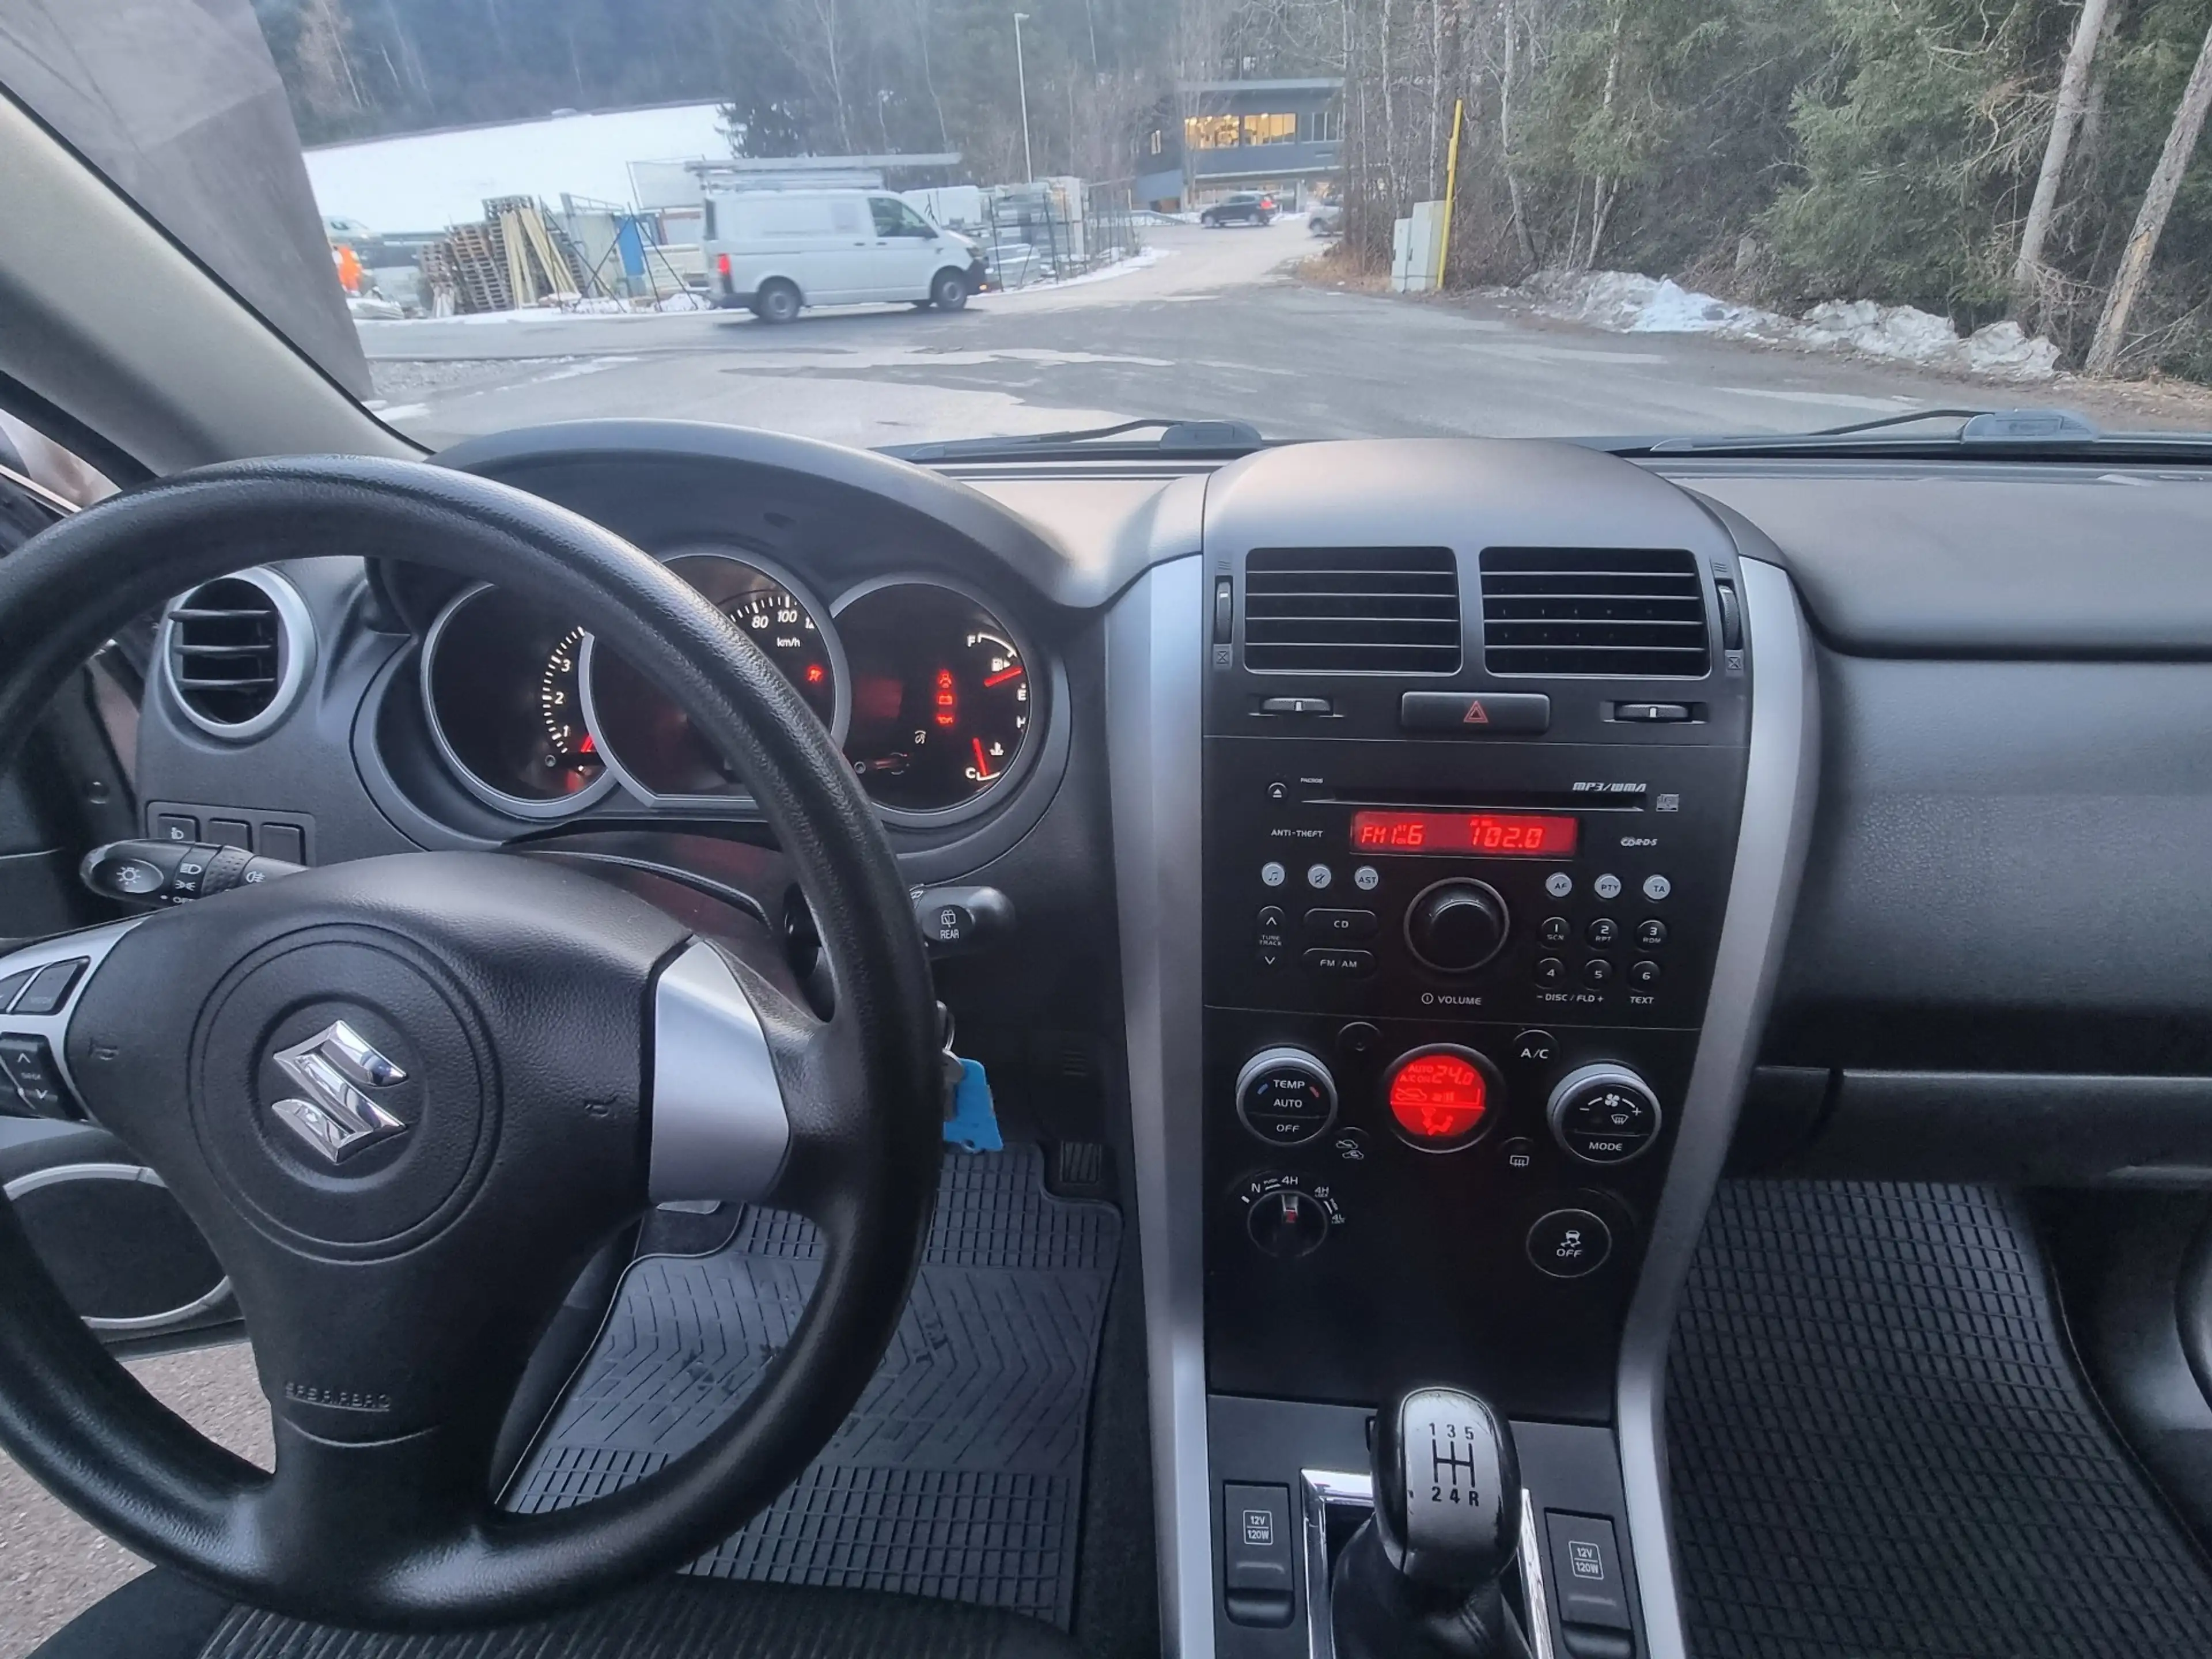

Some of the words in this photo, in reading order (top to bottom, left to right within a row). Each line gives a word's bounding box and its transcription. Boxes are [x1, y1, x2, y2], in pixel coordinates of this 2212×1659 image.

[778, 609, 797, 623] 100
[752, 615, 768, 628] 80
[777, 637, 801, 647] km/h
[967, 636, 975, 647] F
[560, 660, 571, 672] 3
[554, 692, 564, 704] 2
[1018, 689, 1027, 700] E
[1017, 716, 1025, 728] H
[563, 726, 569, 737] 1
[965, 768, 976, 778] C
[1573, 782, 1646, 792] MP3/WMA
[1271, 829, 1323, 838] ANTI-THEFT
[1471, 827, 1544, 849] 102.0
[1555, 924, 1558, 932] 1
[1601, 925, 1609, 934] 2
[1650, 927, 1657, 935] 3
[940, 929, 959, 939] REAR
[1594, 971, 1603, 979] 5
[1642, 972, 1651, 980] 6
[1438, 995, 1482, 1005] VOLUME
[1630, 996, 1654, 1004] TEXT
[1520, 1048, 1549, 1059] A/C
[1408, 1065, 1434, 1073] AUTO
[1273, 1080, 1305, 1089] TEMP
[1273, 1099, 1302, 1108] AUTO
[1277, 1124, 1300, 1132] OFF
[1589, 1142, 1623, 1151] MODE
[1282, 1176, 1298, 1185] 4H
[1251, 1183, 1260, 1193] N
[1556, 1248, 1582, 1258] OFF
[1429, 1423, 1435, 1435] 1
[1446, 1425, 1456, 1438] 3
[1465, 1426, 1474, 1440] 5
[1431, 1486, 1442, 1502] 2
[1449, 1488, 1460, 1503] 4
[1469, 1491, 1479, 1507] R
[1250, 1516, 1266, 1526] 12V
[1247, 1529, 1269, 1540] 120W
[1576, 1548, 1593, 1558] 12V
[1576, 1563, 1599, 1574] 120W
